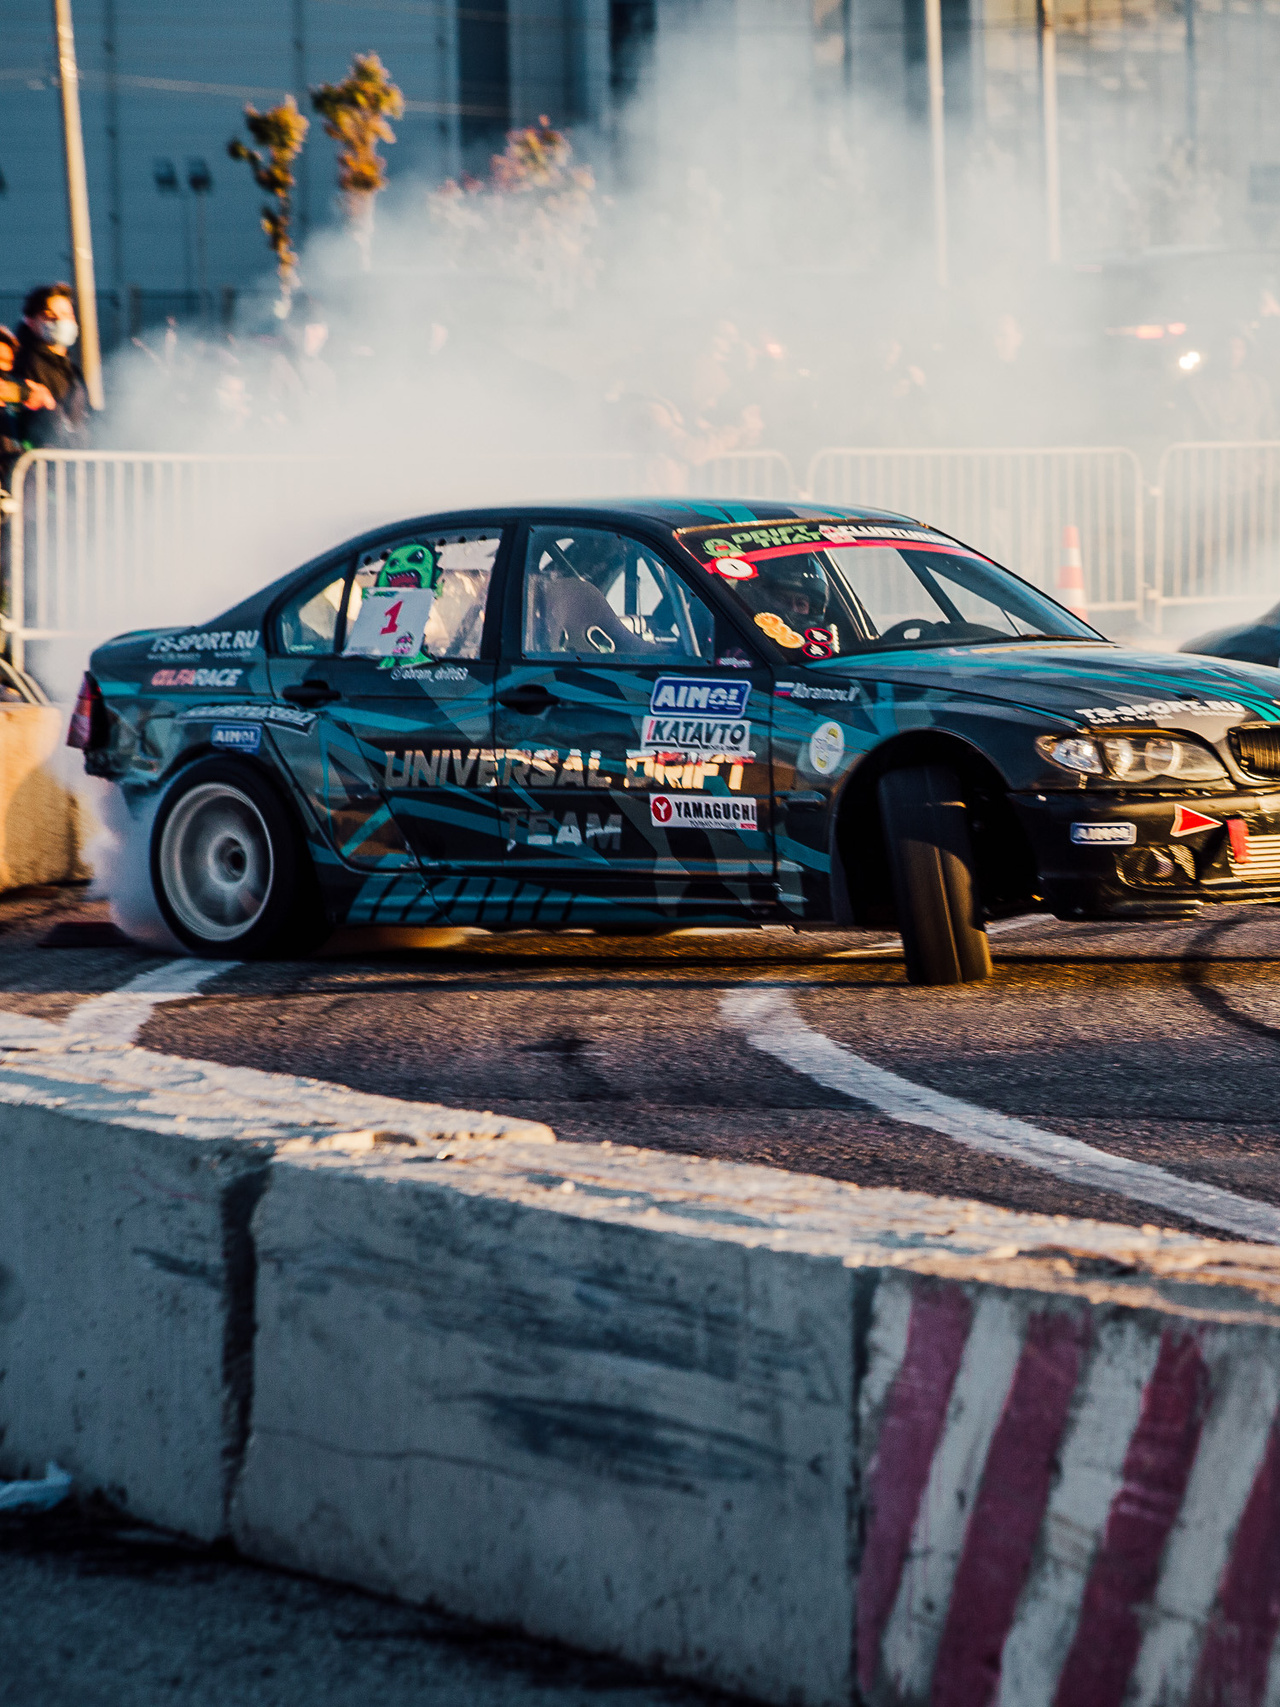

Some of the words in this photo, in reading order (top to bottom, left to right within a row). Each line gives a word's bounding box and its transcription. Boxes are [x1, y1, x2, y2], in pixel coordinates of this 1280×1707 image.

[380, 600, 404, 635] 1
[654, 684, 742, 710] AIMOL
[384, 749, 612, 789] UNIVERSAL
[623, 750, 755, 790] DRIFT
[675, 801, 757, 822] YAMAGUCHI
[504, 808, 623, 851] TEAM
